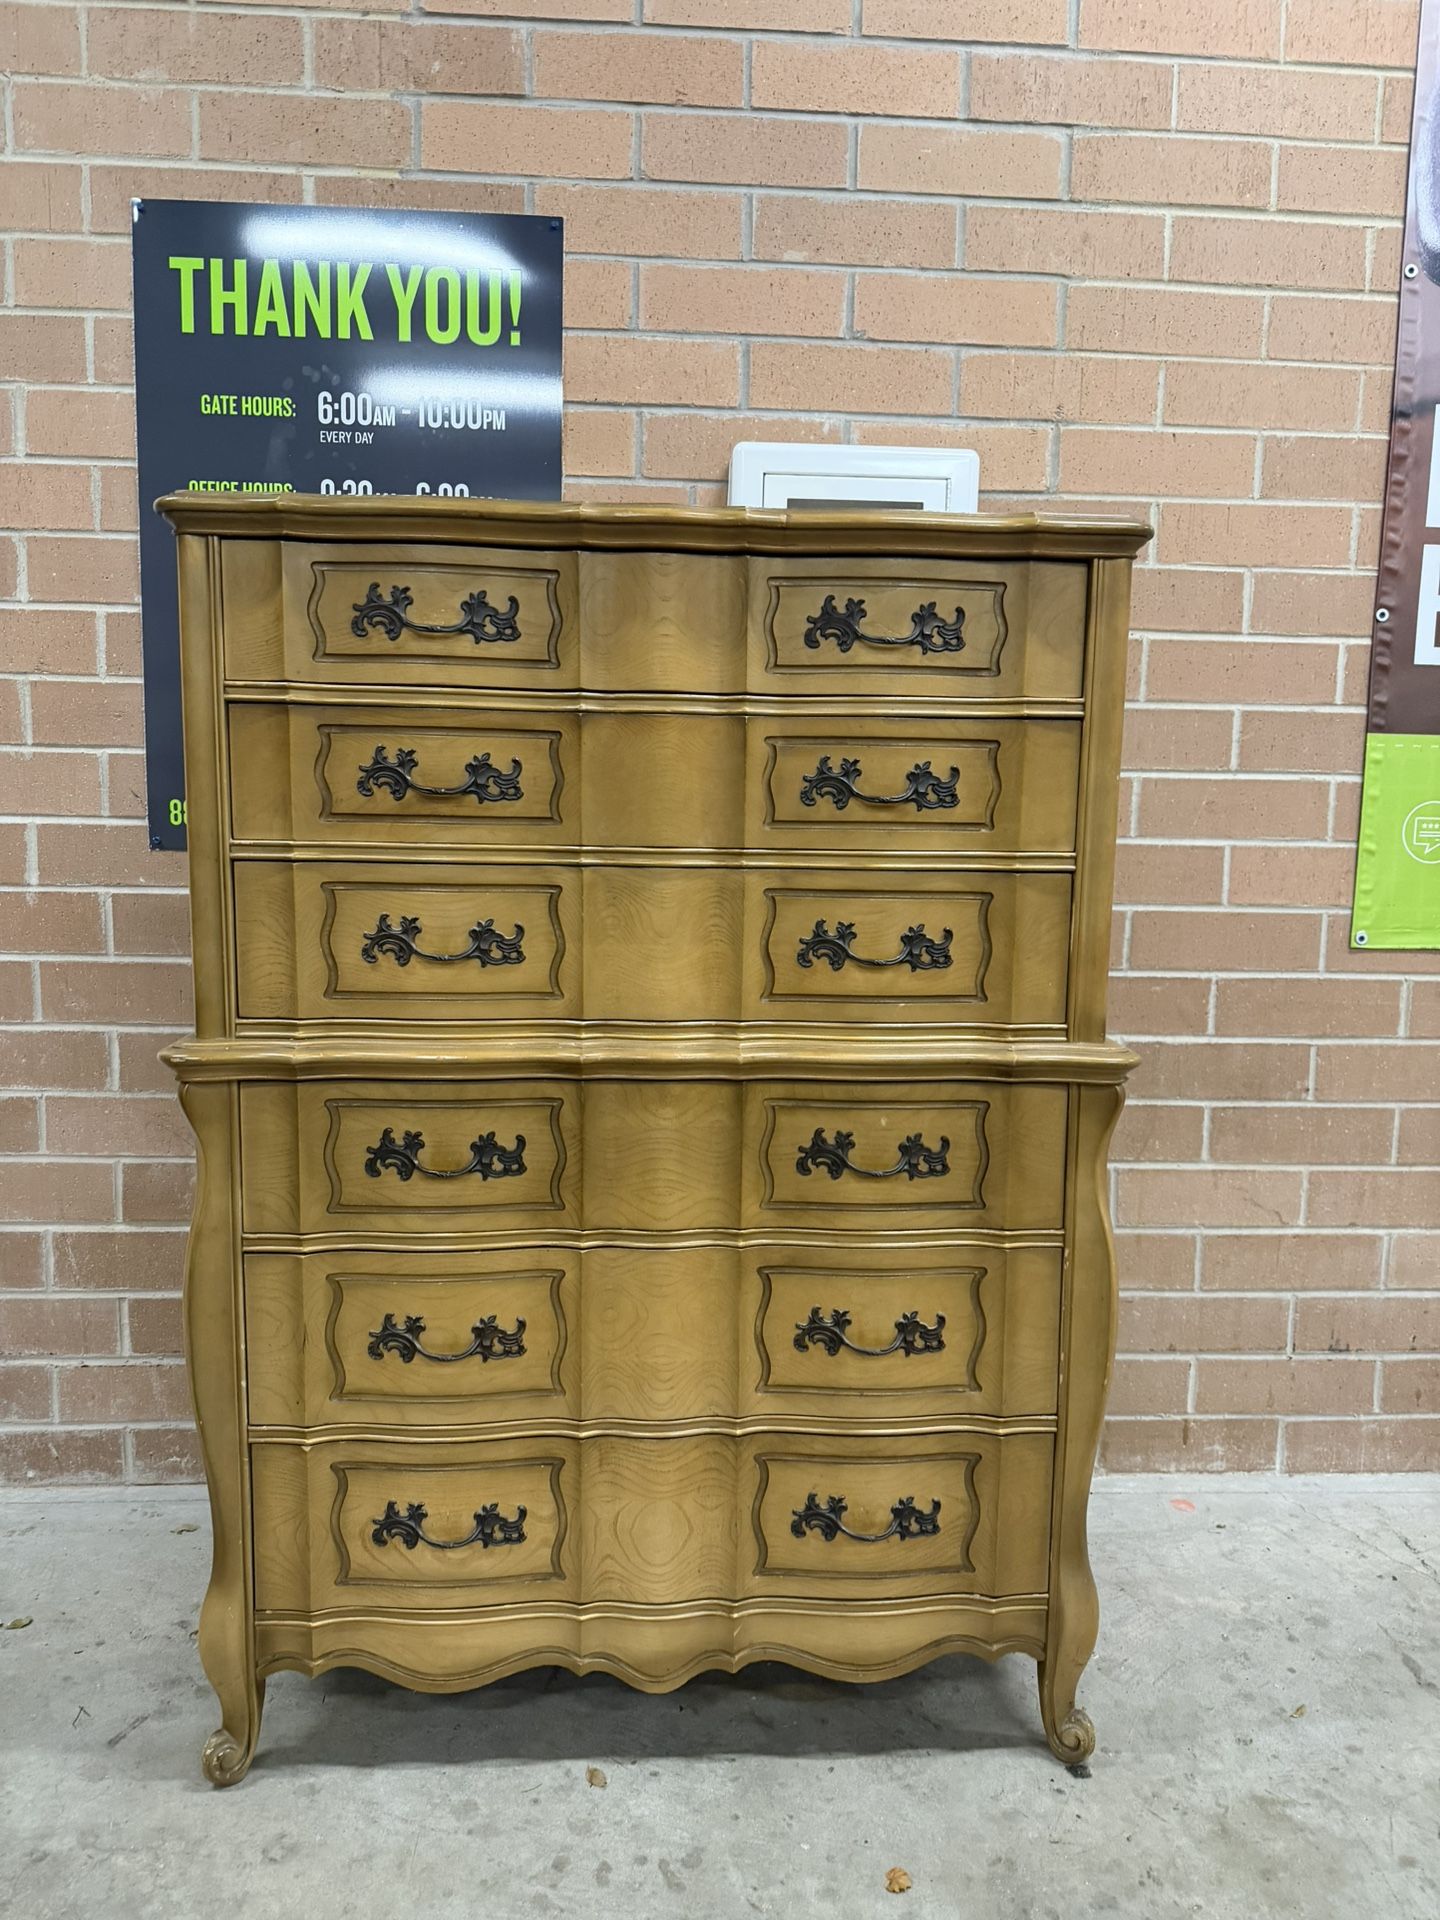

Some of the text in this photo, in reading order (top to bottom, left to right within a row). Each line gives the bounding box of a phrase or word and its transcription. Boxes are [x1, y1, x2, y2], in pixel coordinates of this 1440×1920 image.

[169, 256, 522, 346] THANK YOU!
[201, 394, 297, 417] GATE HOURS:
[317, 391, 396, 426] 6:00AM
[320, 430, 374, 445] EVERY DAY
